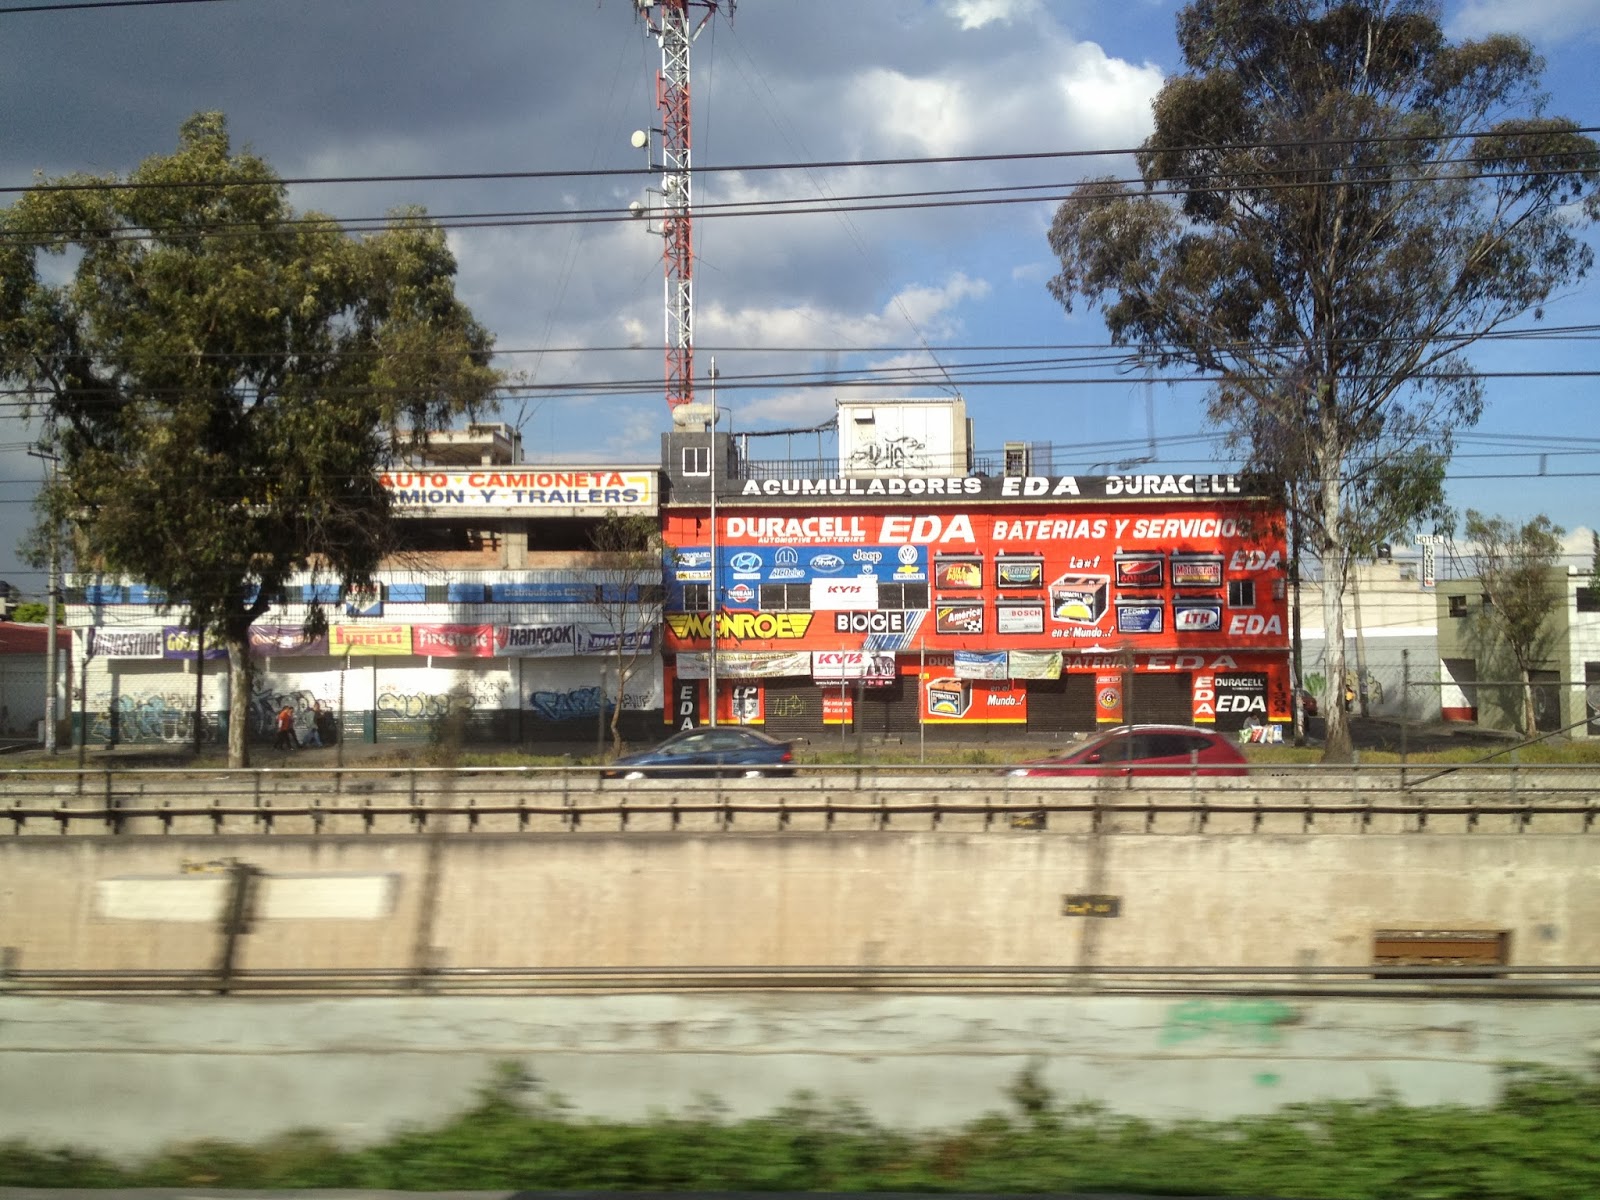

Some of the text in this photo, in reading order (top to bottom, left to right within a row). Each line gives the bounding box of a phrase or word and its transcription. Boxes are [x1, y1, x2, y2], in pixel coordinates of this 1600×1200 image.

[379, 472, 625, 488] AUTO CAMIONETA
[741, 475, 1241, 496] ACUMULADORES EDA DURACELL
[480, 489, 496, 503] Y
[512, 488, 639, 504] TRAILERS
[727, 516, 867, 538] DURACELL
[878, 514, 976, 543] EDA
[992, 520, 1107, 541] BATERIAS
[1114, 520, 1131, 540] Y
[853, 549, 882, 563] Jeep
[1228, 550, 1282, 571] EDA
[837, 614, 903, 630] BOGE
[1184, 613, 1210, 624] LTH
[1228, 615, 1283, 635] EDA
[335, 626, 402, 645] PIRELLI
[418, 628, 488, 648] Firestone
[1147, 655, 1239, 669] EDA
[1215, 679, 1264, 687] DURACELL
[1215, 695, 1267, 712] EDA
